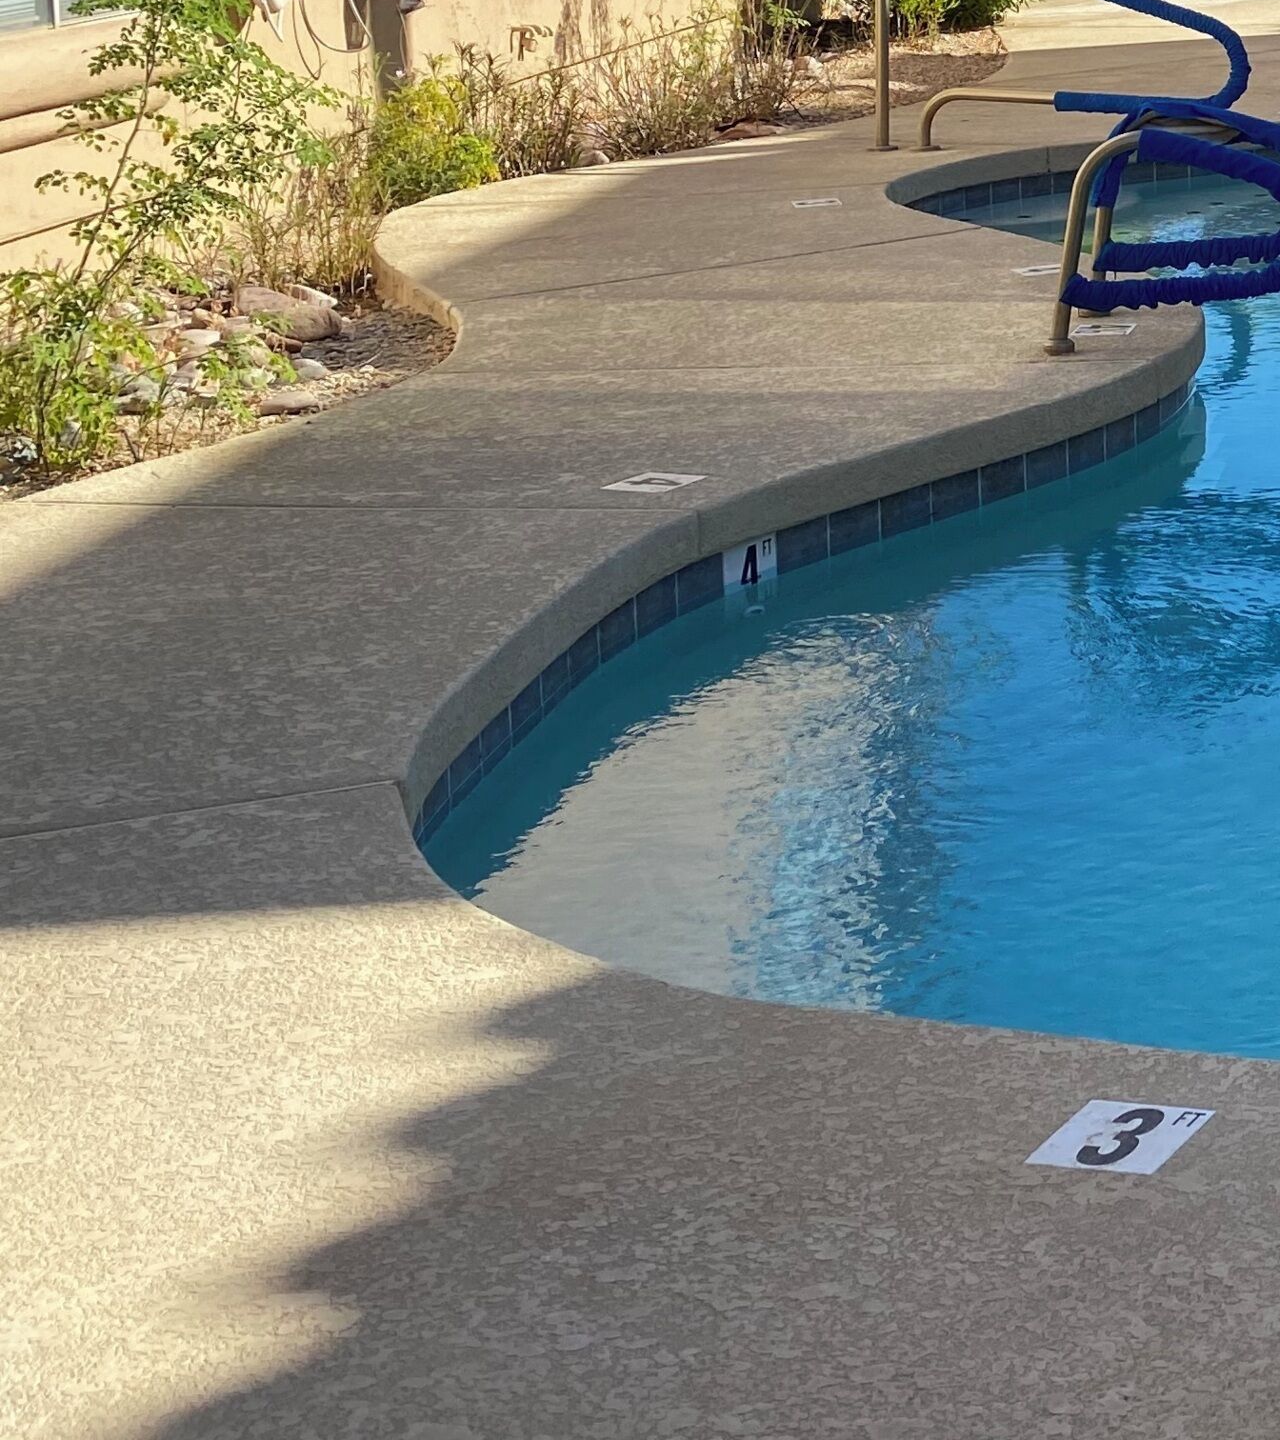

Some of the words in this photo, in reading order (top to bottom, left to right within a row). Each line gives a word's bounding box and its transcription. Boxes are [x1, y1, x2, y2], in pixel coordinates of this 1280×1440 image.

[740, 544, 761, 585] 4
[762, 538, 772, 557] FT
[1076, 1108, 1165, 1166] 3
[1172, 1111, 1207, 1127] FT
